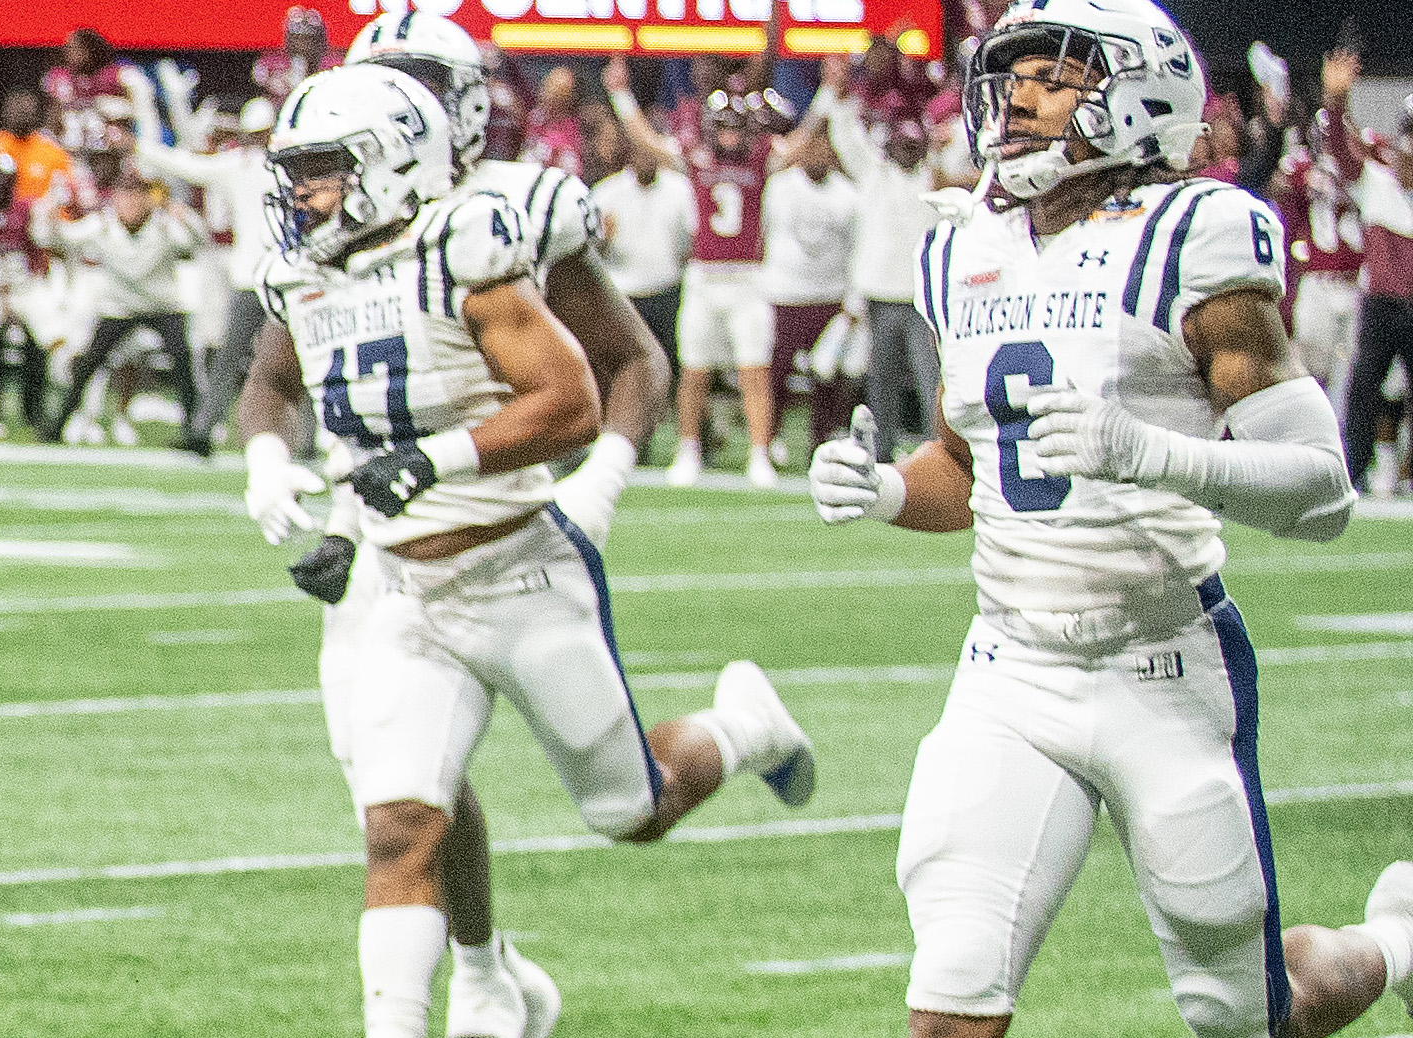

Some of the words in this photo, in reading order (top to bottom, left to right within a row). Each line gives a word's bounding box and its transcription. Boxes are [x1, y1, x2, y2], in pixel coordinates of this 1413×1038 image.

[710, 182, 743, 238] 3
[1249, 209, 1273, 266] 6
[955, 294, 1037, 341] JACKSON
[1043, 290, 1108, 329] STATE
[323, 334, 417, 450] 47
[984, 340, 1074, 512] 6
